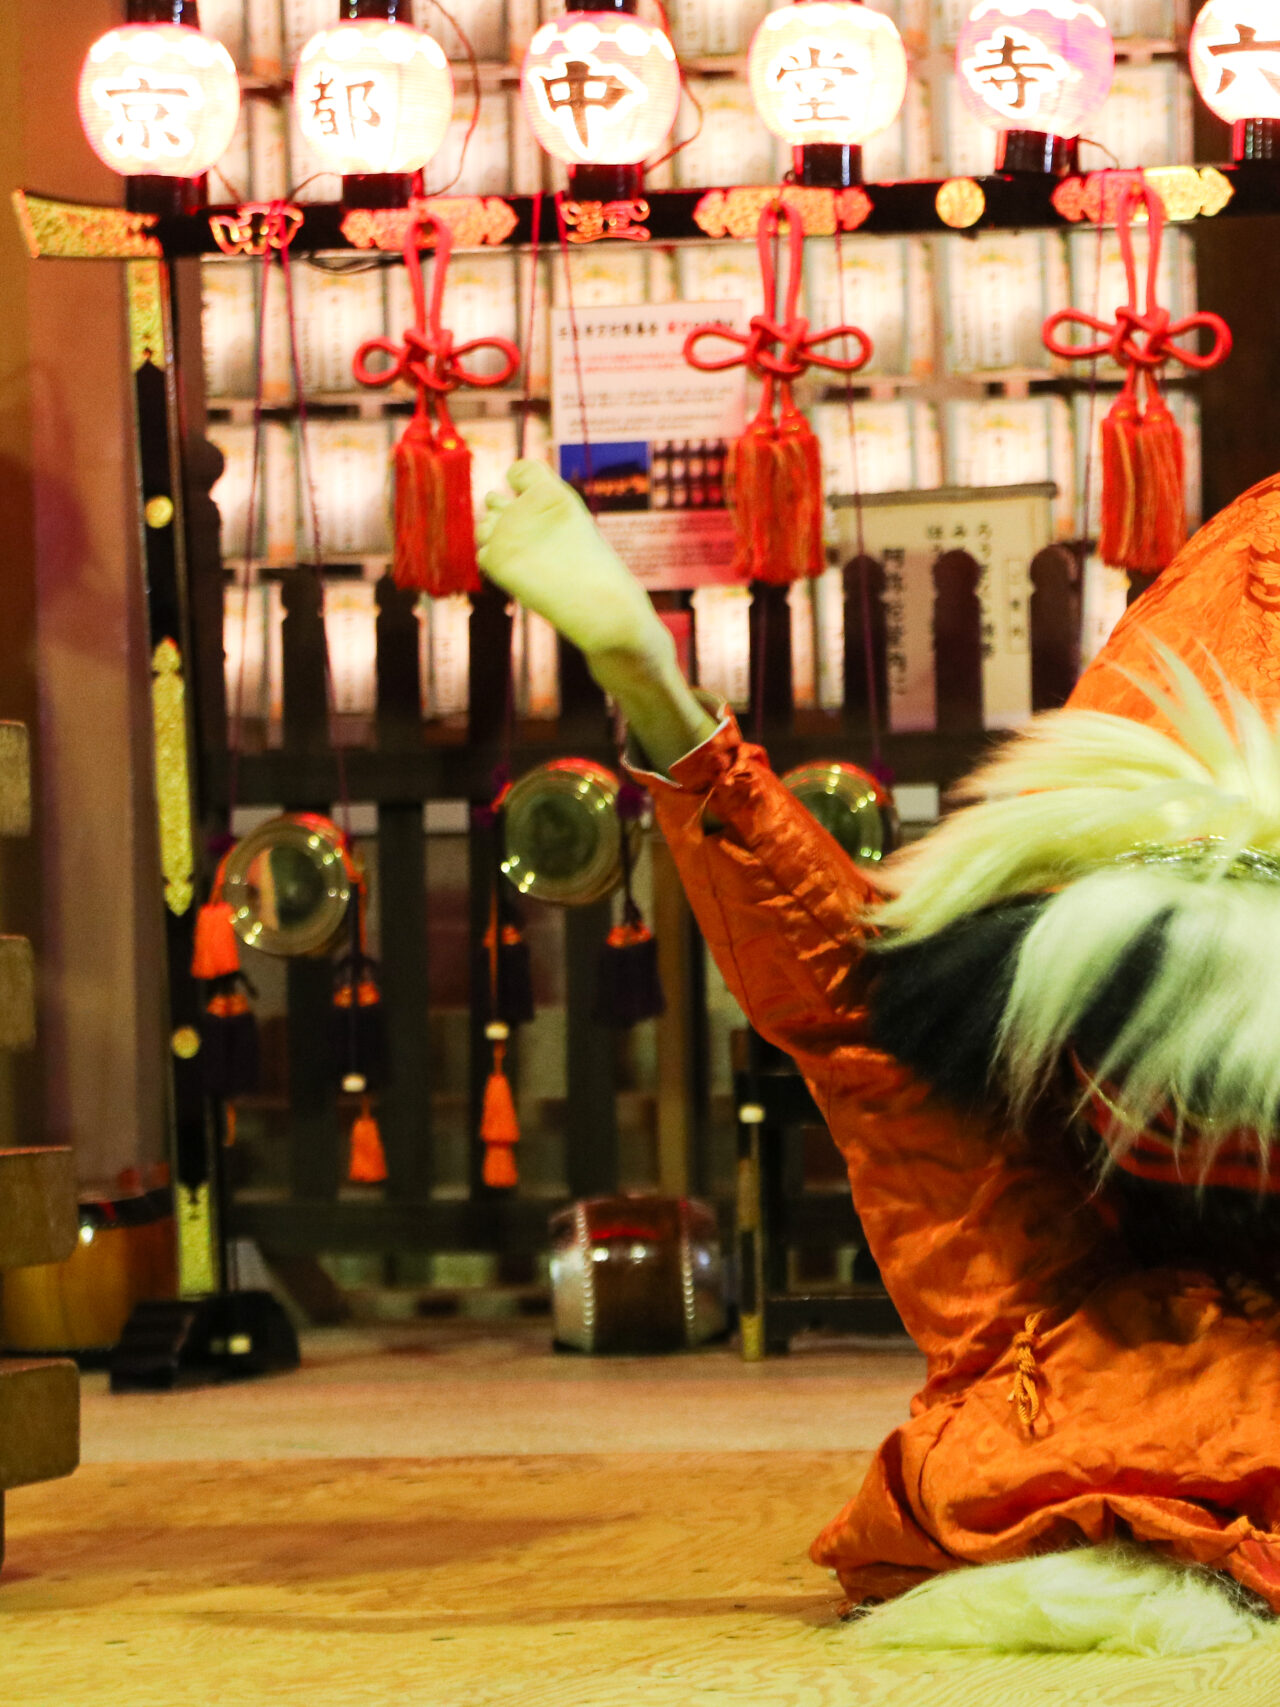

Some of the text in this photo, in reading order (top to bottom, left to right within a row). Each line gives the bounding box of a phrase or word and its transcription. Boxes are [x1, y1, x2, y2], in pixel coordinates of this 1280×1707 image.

[105, 77, 188, 149] 京
[310, 71, 382, 137] 都
[539, 61, 630, 148] 中
[777, 47, 857, 122] 堂
[974, 35, 1055, 108] 寺
